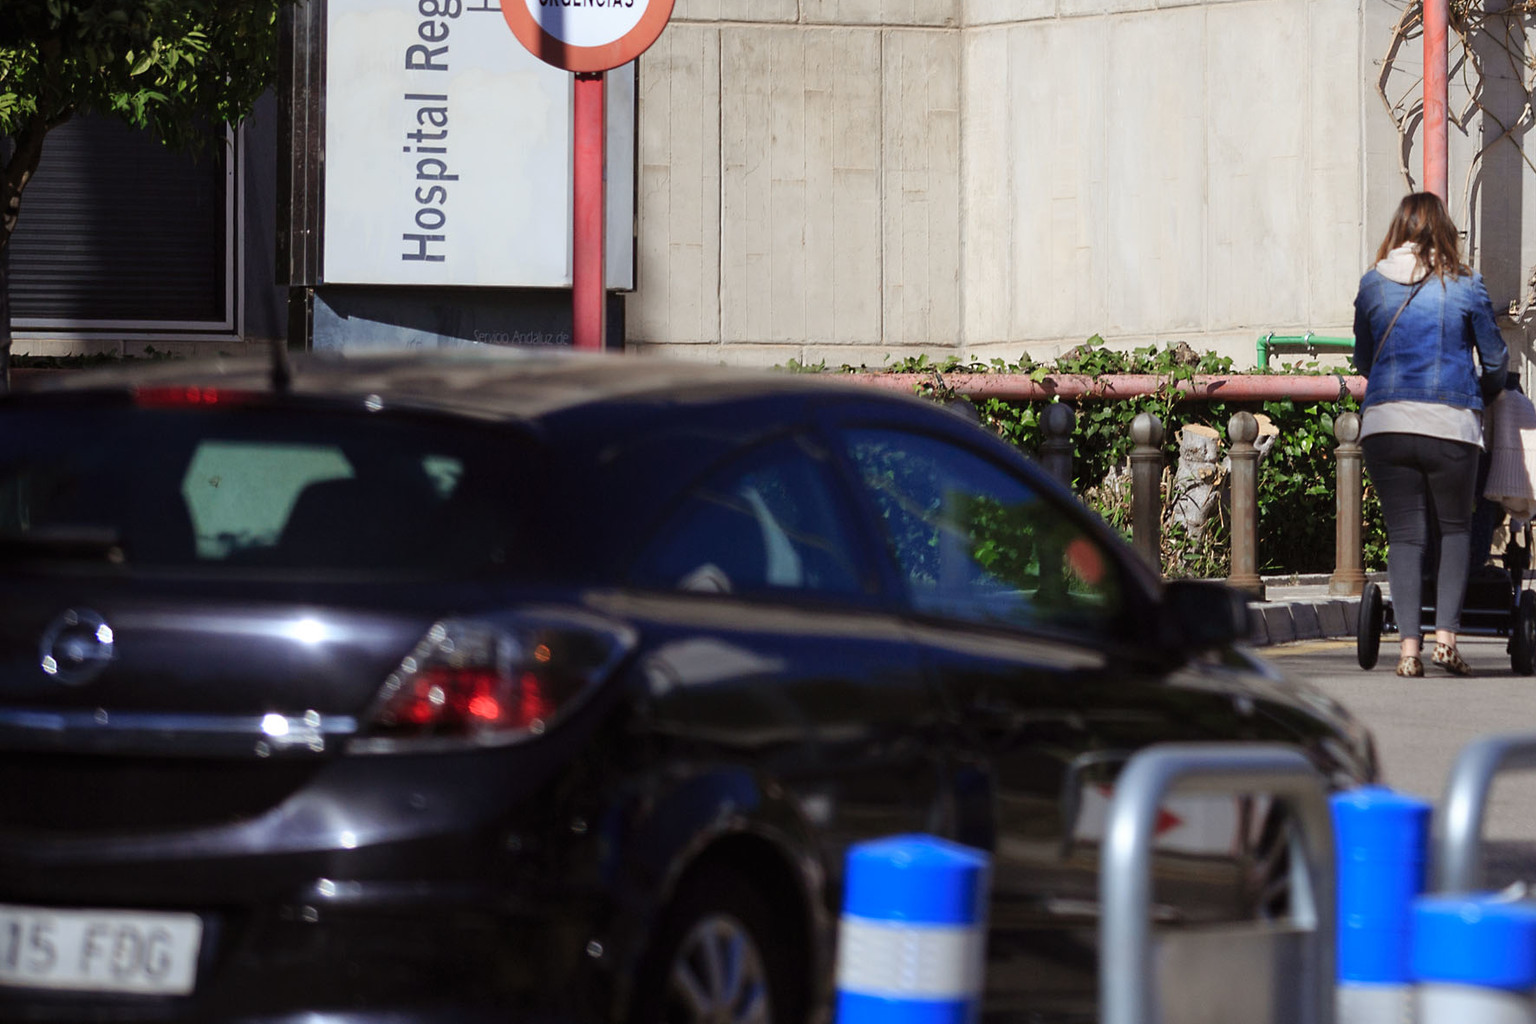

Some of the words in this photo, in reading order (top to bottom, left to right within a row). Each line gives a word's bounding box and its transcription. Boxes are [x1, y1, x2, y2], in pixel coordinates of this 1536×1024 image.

[402, 92, 459, 263] Hospital
[473, 329, 509, 344] Servicio
[513, 330, 552, 344] Andaluz
[555, 332, 569, 345] de
